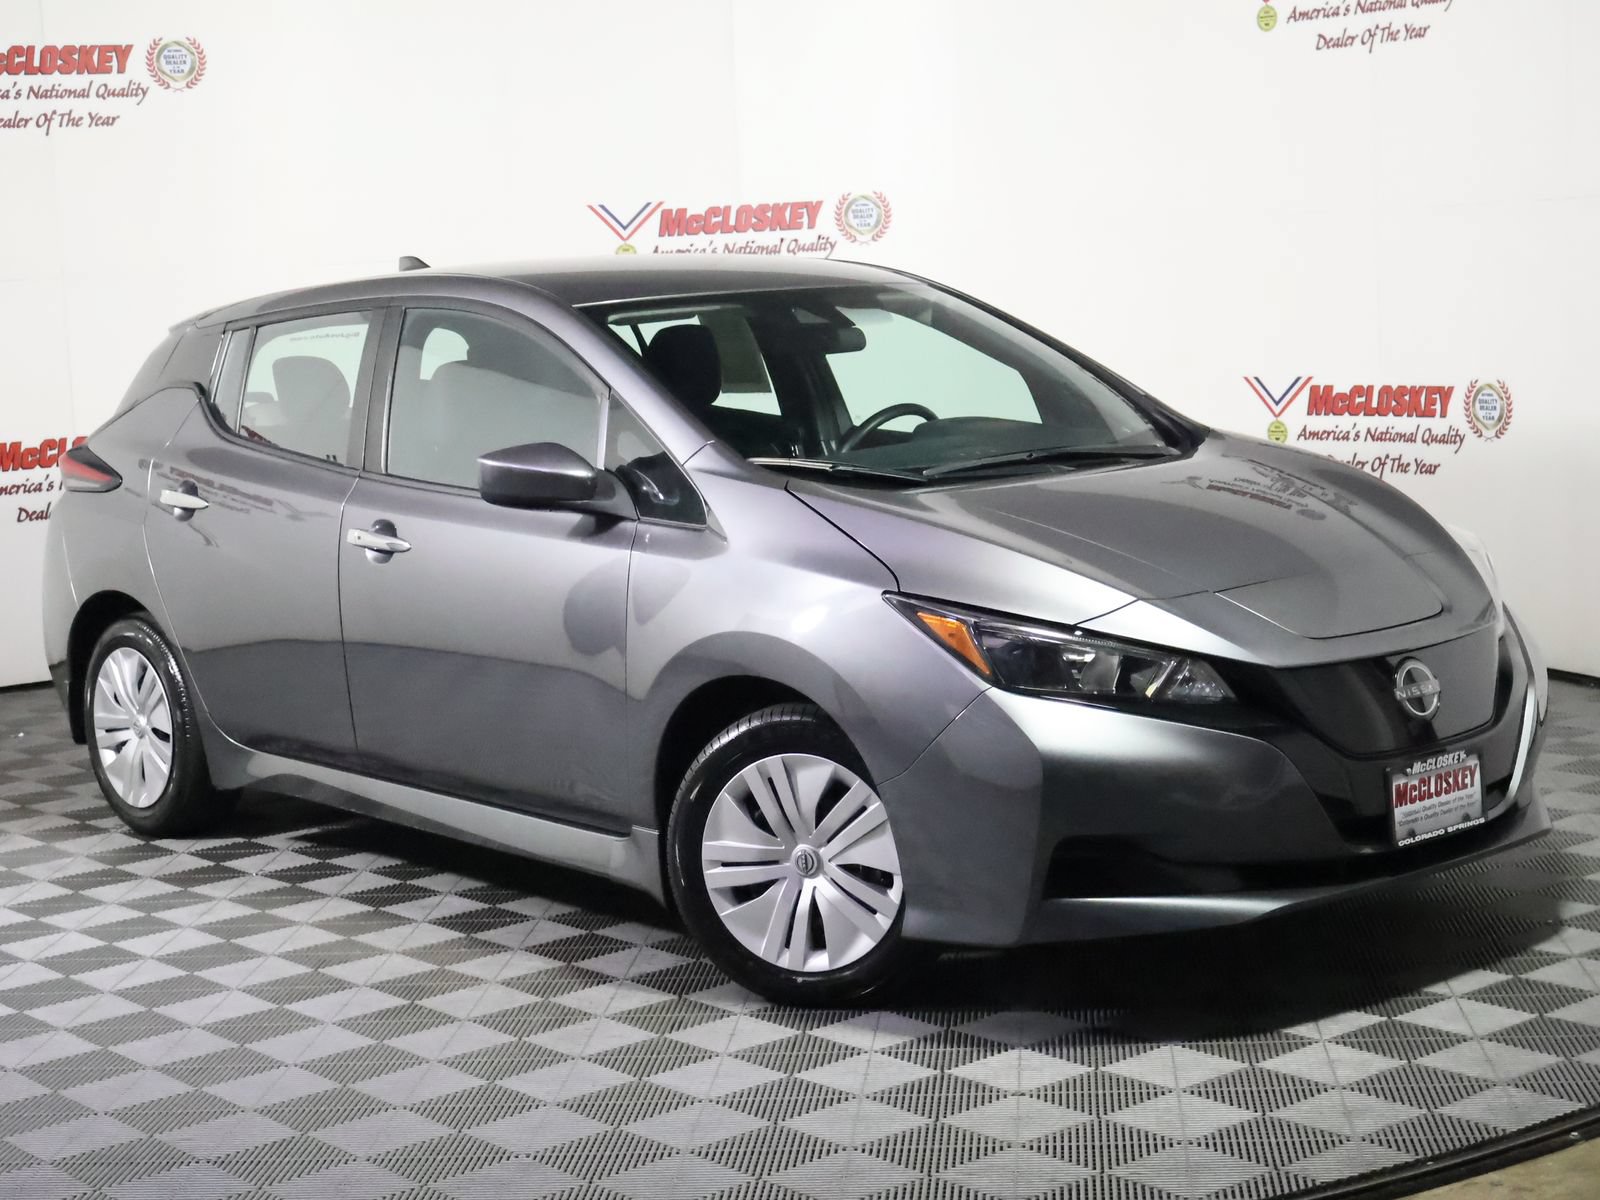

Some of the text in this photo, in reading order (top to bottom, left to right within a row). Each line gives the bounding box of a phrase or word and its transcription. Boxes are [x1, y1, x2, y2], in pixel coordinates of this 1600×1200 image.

[1316, 22, 1430, 53] Dealer Of The Year
[26, 80, 94, 100] National
[95, 79, 149, 106] Quality
[36, 109, 57, 136] Of
[57, 108, 84, 128] The
[88, 111, 120, 128] Year
[658, 200, 824, 237] McCLOSKEY
[722, 238, 784, 255] National
[787, 234, 836, 259] Quality
[1307, 384, 1455, 418] McCLOSKEY
[1297, 422, 1360, 443] America's
[1363, 423, 1417, 445] National
[1421, 425, 1465, 454] Quality
[1371, 453, 1389, 480] Of
[1390, 453, 1411, 474] The
[1413, 458, 1440, 476] Year
[1394, 763, 1478, 809] McCLOSKEY
[1398, 817, 1485, 847] COLORADO SPRINGS
